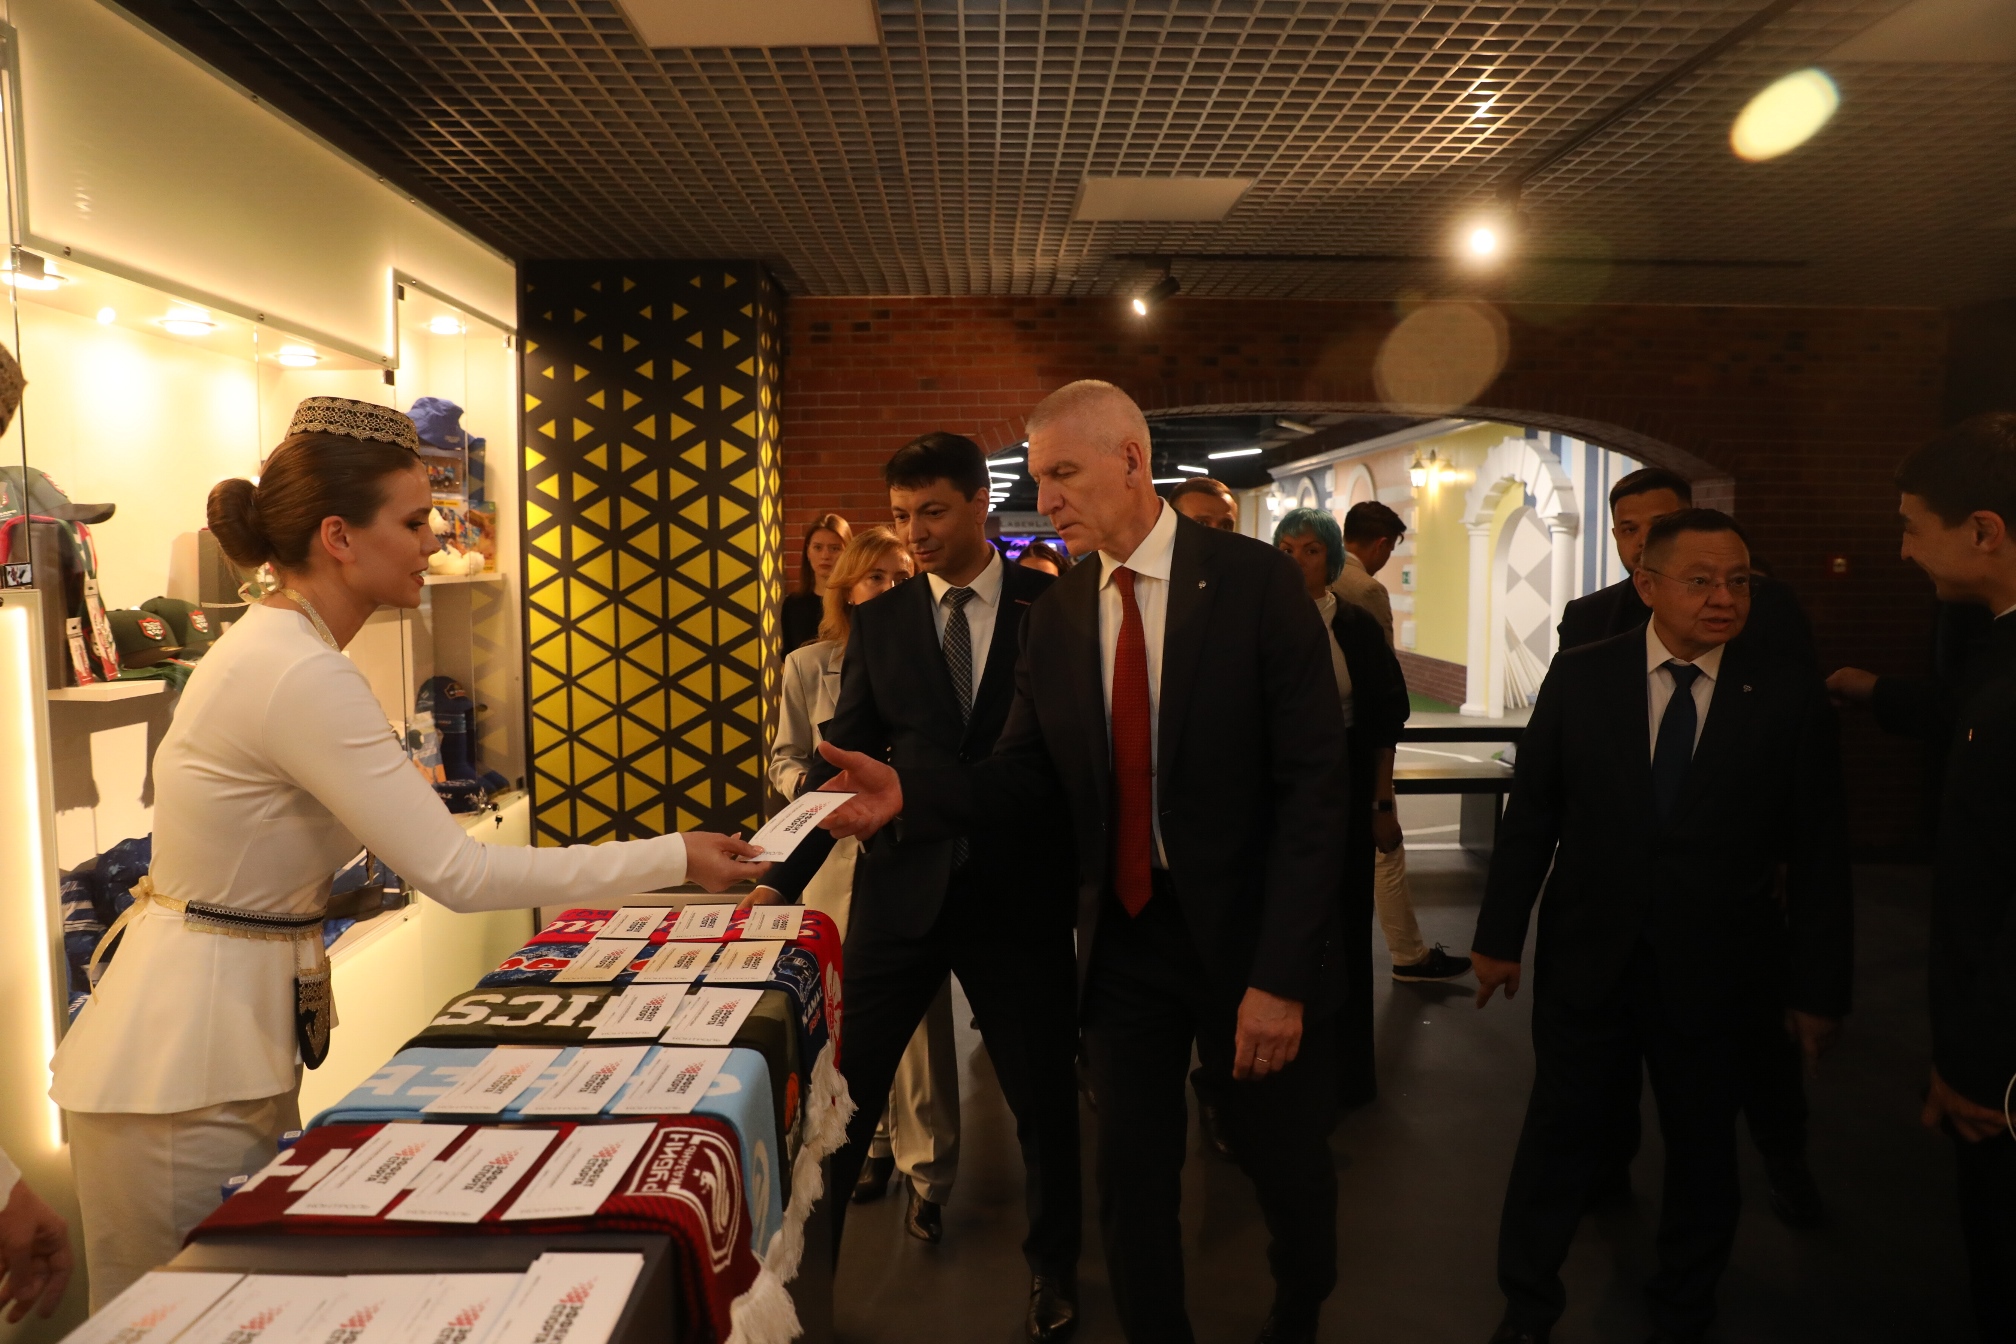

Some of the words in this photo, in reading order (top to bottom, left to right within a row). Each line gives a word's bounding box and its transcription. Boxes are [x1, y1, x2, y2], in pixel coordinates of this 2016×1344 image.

[783, 812, 809, 832] СПОРТА
[789, 812, 816, 834] ЭФФЕКТ
[365, 1156, 399, 1182] СПОРТА
[376, 1156, 413, 1185] ЭФФЕКТ
[462, 1164, 495, 1191] СПОРТА
[571, 1157, 599, 1186] СПОРТА
[583, 1157, 612, 1188] ЭФФЕКТ
[641, 1133, 689, 1193] РУБИН
[671, 1145, 697, 1187] КАЗАНЬ
[474, 1165, 509, 1194] ЭФФЕКТ
